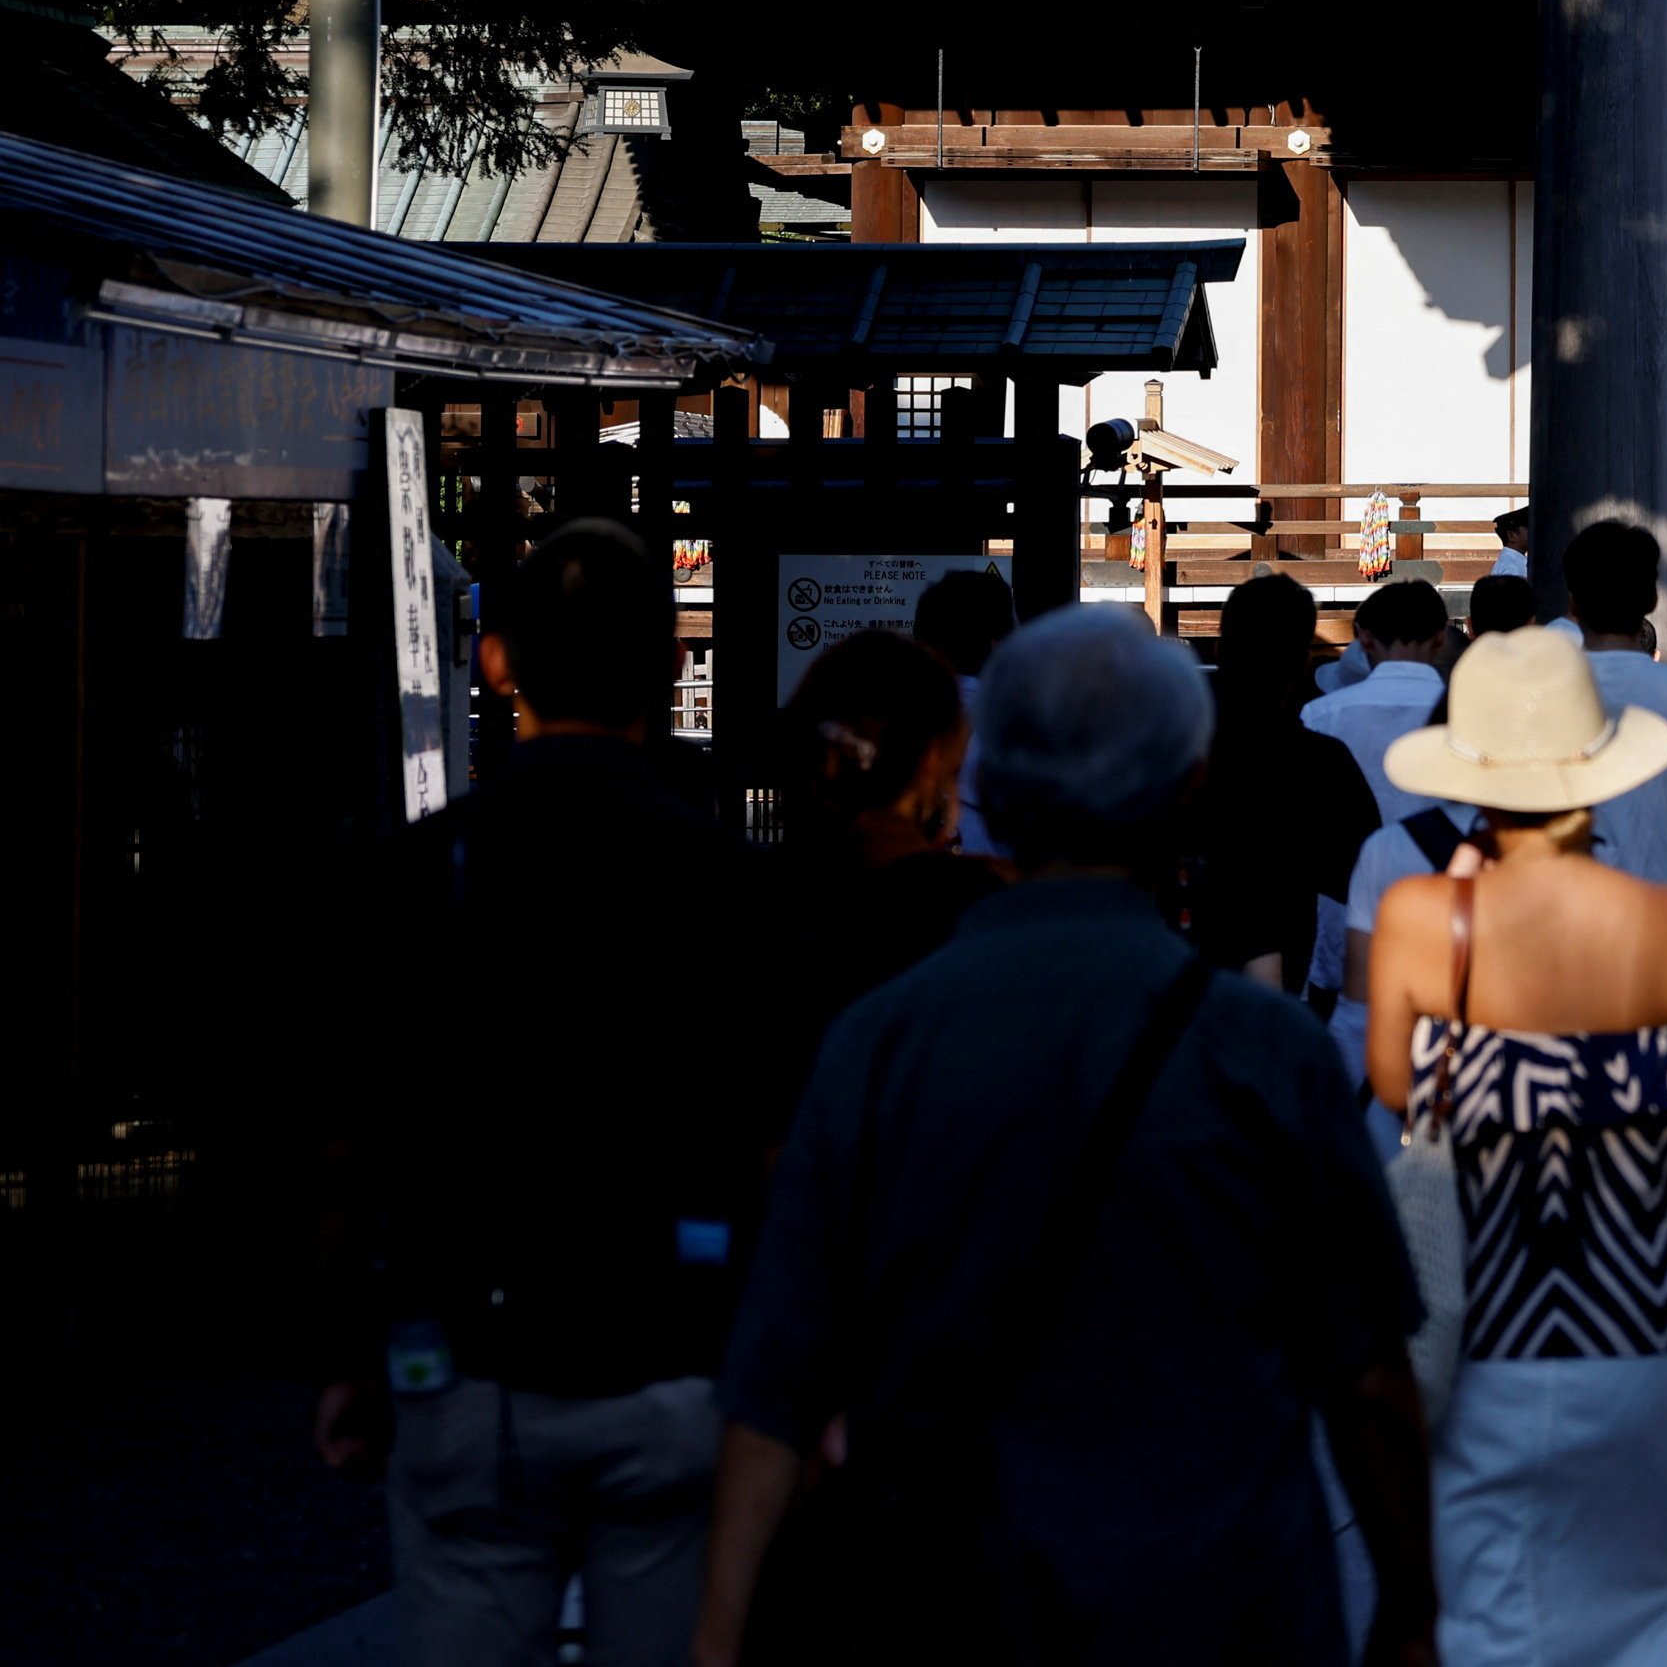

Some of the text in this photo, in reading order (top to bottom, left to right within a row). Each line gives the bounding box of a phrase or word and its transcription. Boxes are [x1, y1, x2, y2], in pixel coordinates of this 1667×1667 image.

[869, 560, 922, 568] すべての皆様へ
[864, 571, 926, 580] PLEASE NOTE
[824, 585, 893, 594] 飲食はできません
[824, 597, 834, 605] No
[836, 597, 861, 606] Eating
[874, 597, 906, 606] Drinking
